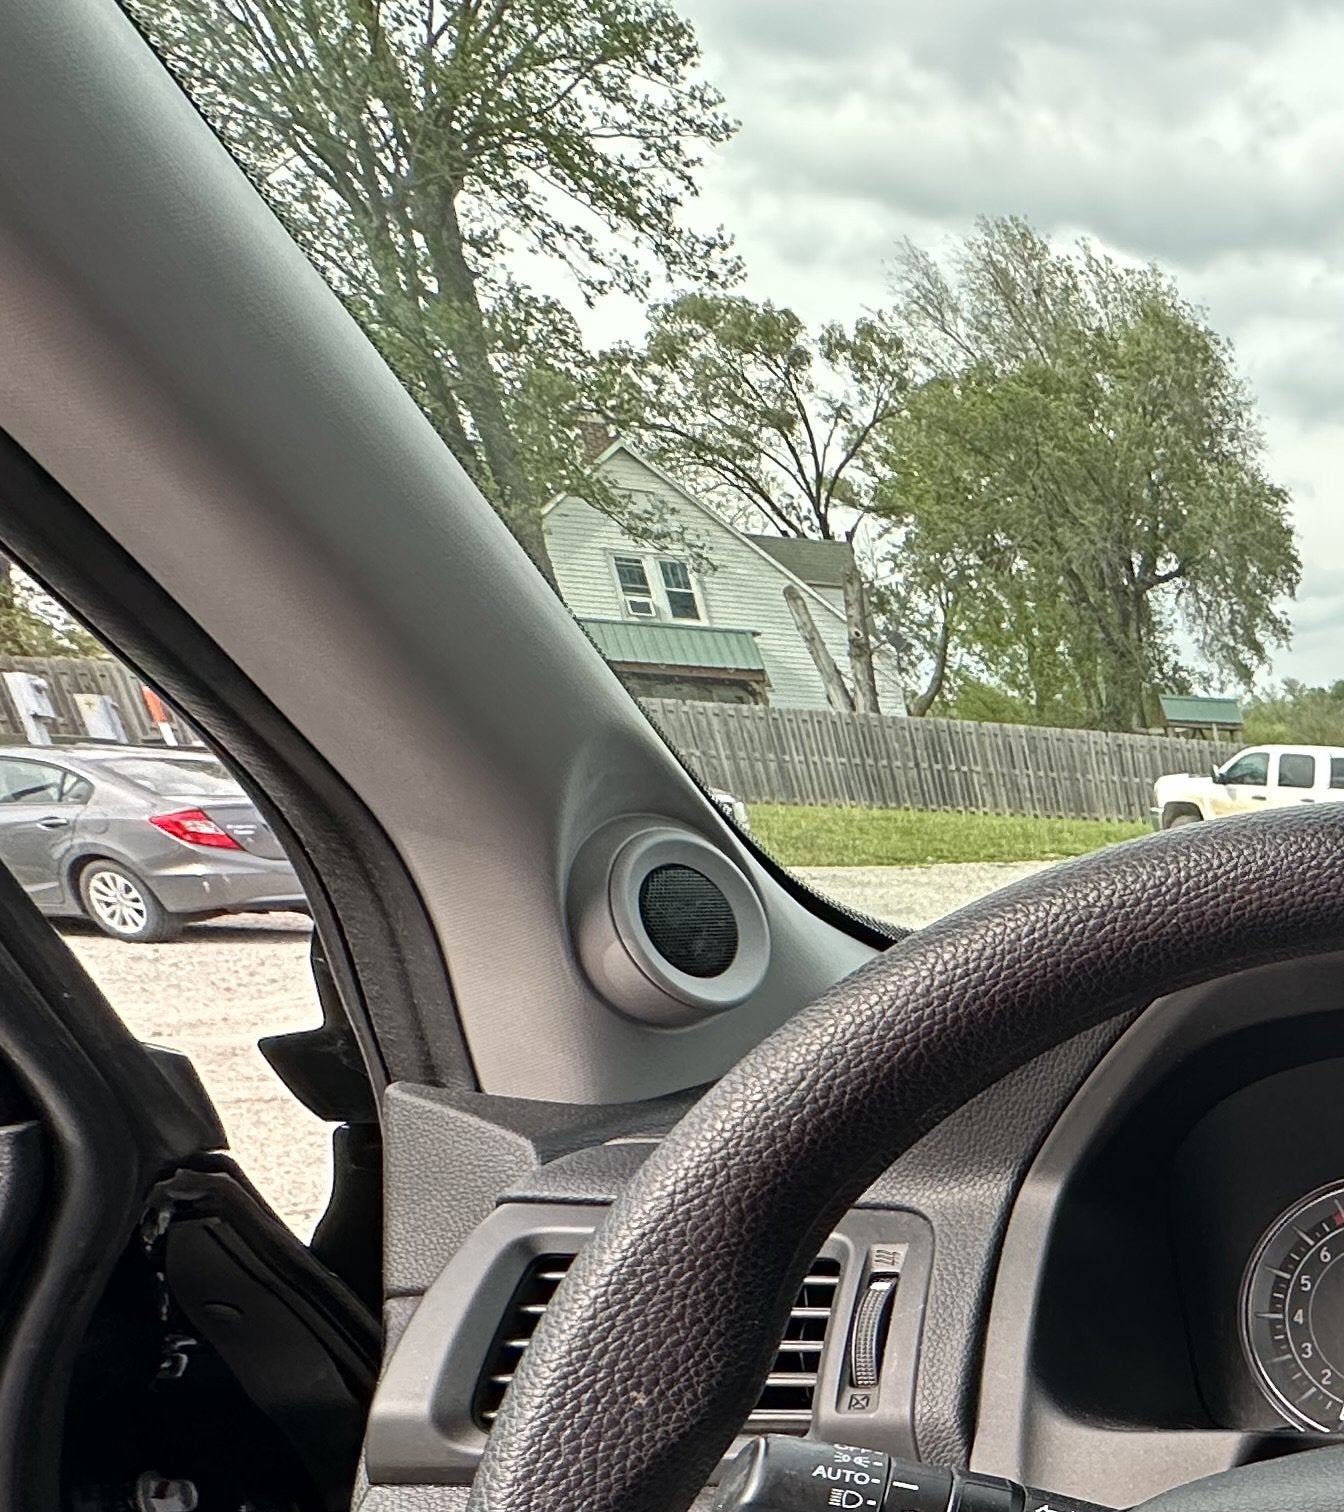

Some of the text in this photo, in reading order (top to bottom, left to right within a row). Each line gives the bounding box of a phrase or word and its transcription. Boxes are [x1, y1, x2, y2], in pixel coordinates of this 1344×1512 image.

[1320, 1247, 1331, 1262] 6
[1301, 1276, 1312, 1291] 5
[1293, 1310, 1304, 1325] 4
[1301, 1343, 1313, 1358] 3
[1321, 1370, 1332, 1385] 2
[812, 1465, 870, 1485] AUTO
